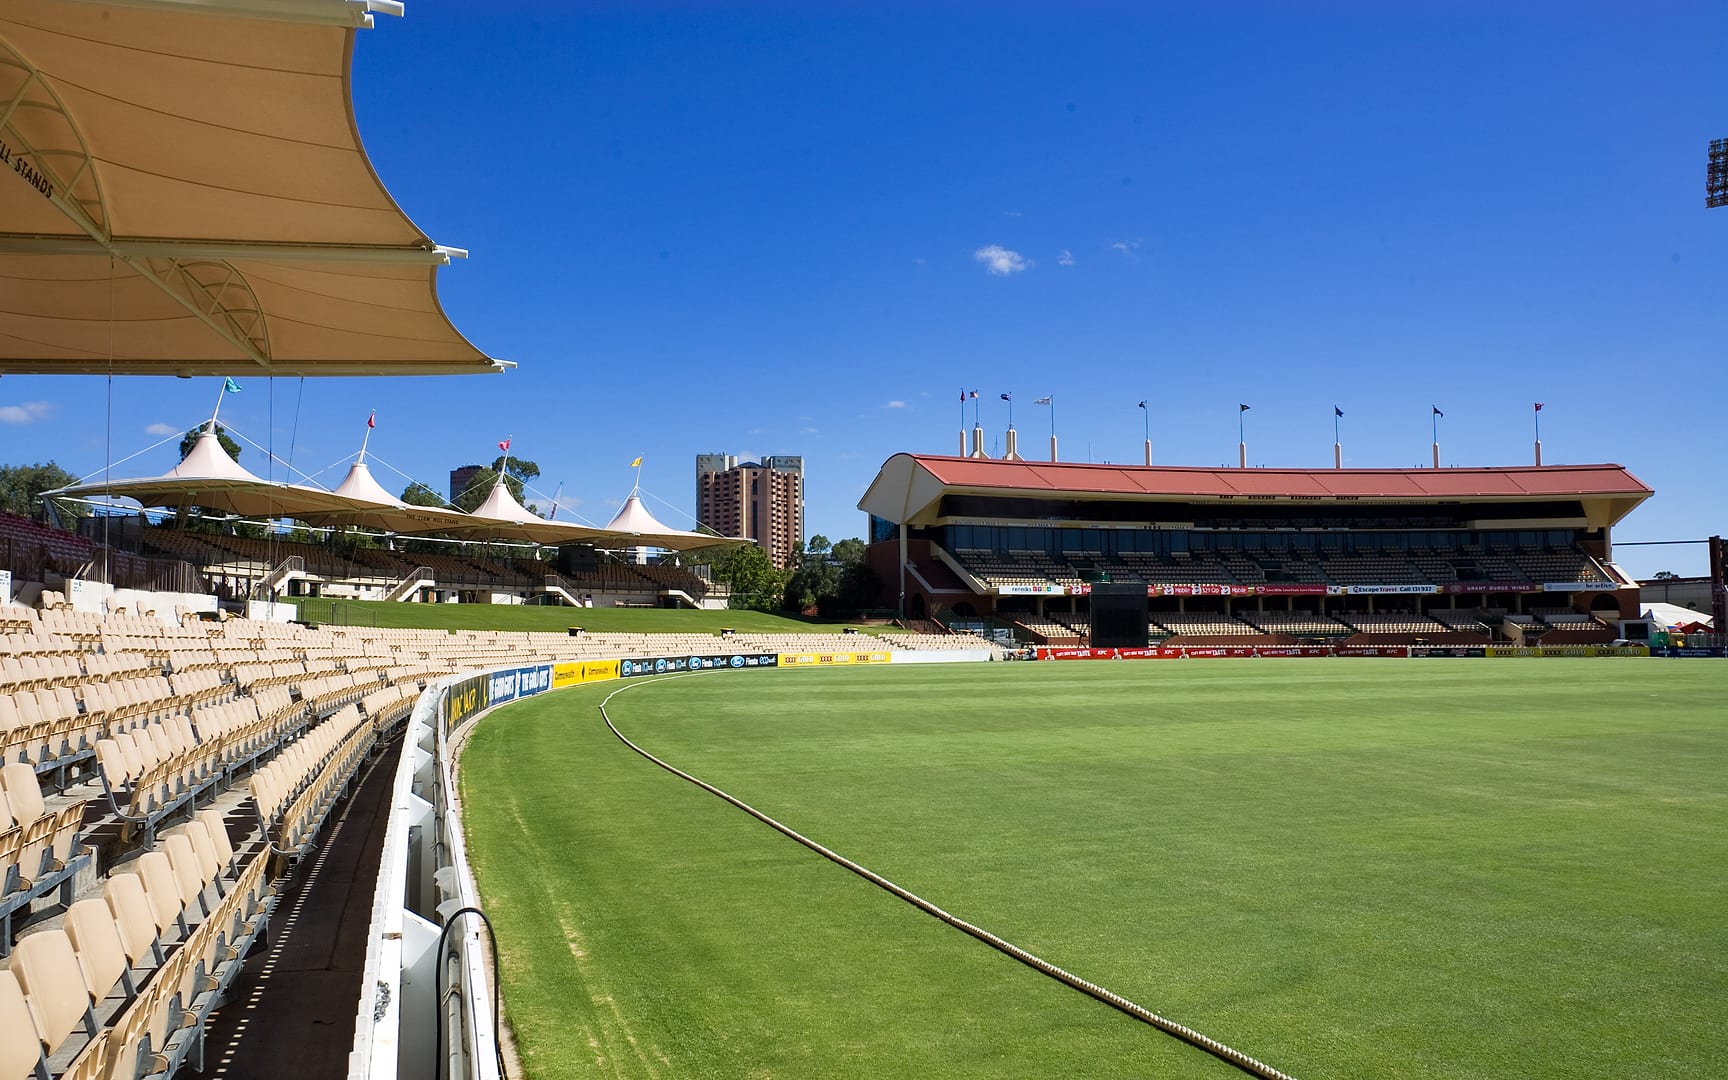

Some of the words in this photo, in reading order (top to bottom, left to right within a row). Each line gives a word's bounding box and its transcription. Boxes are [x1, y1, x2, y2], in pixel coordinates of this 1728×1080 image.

[0, 140, 12, 164] LL
[14, 158, 54, 198] STANDS
[702, 659, 713, 667] Fiesta
[495, 677, 504, 700] GOOD
[504, 675, 515, 697] GUYS
[529, 672, 539, 689] GOOD
[539, 670, 549, 687] GUYS
